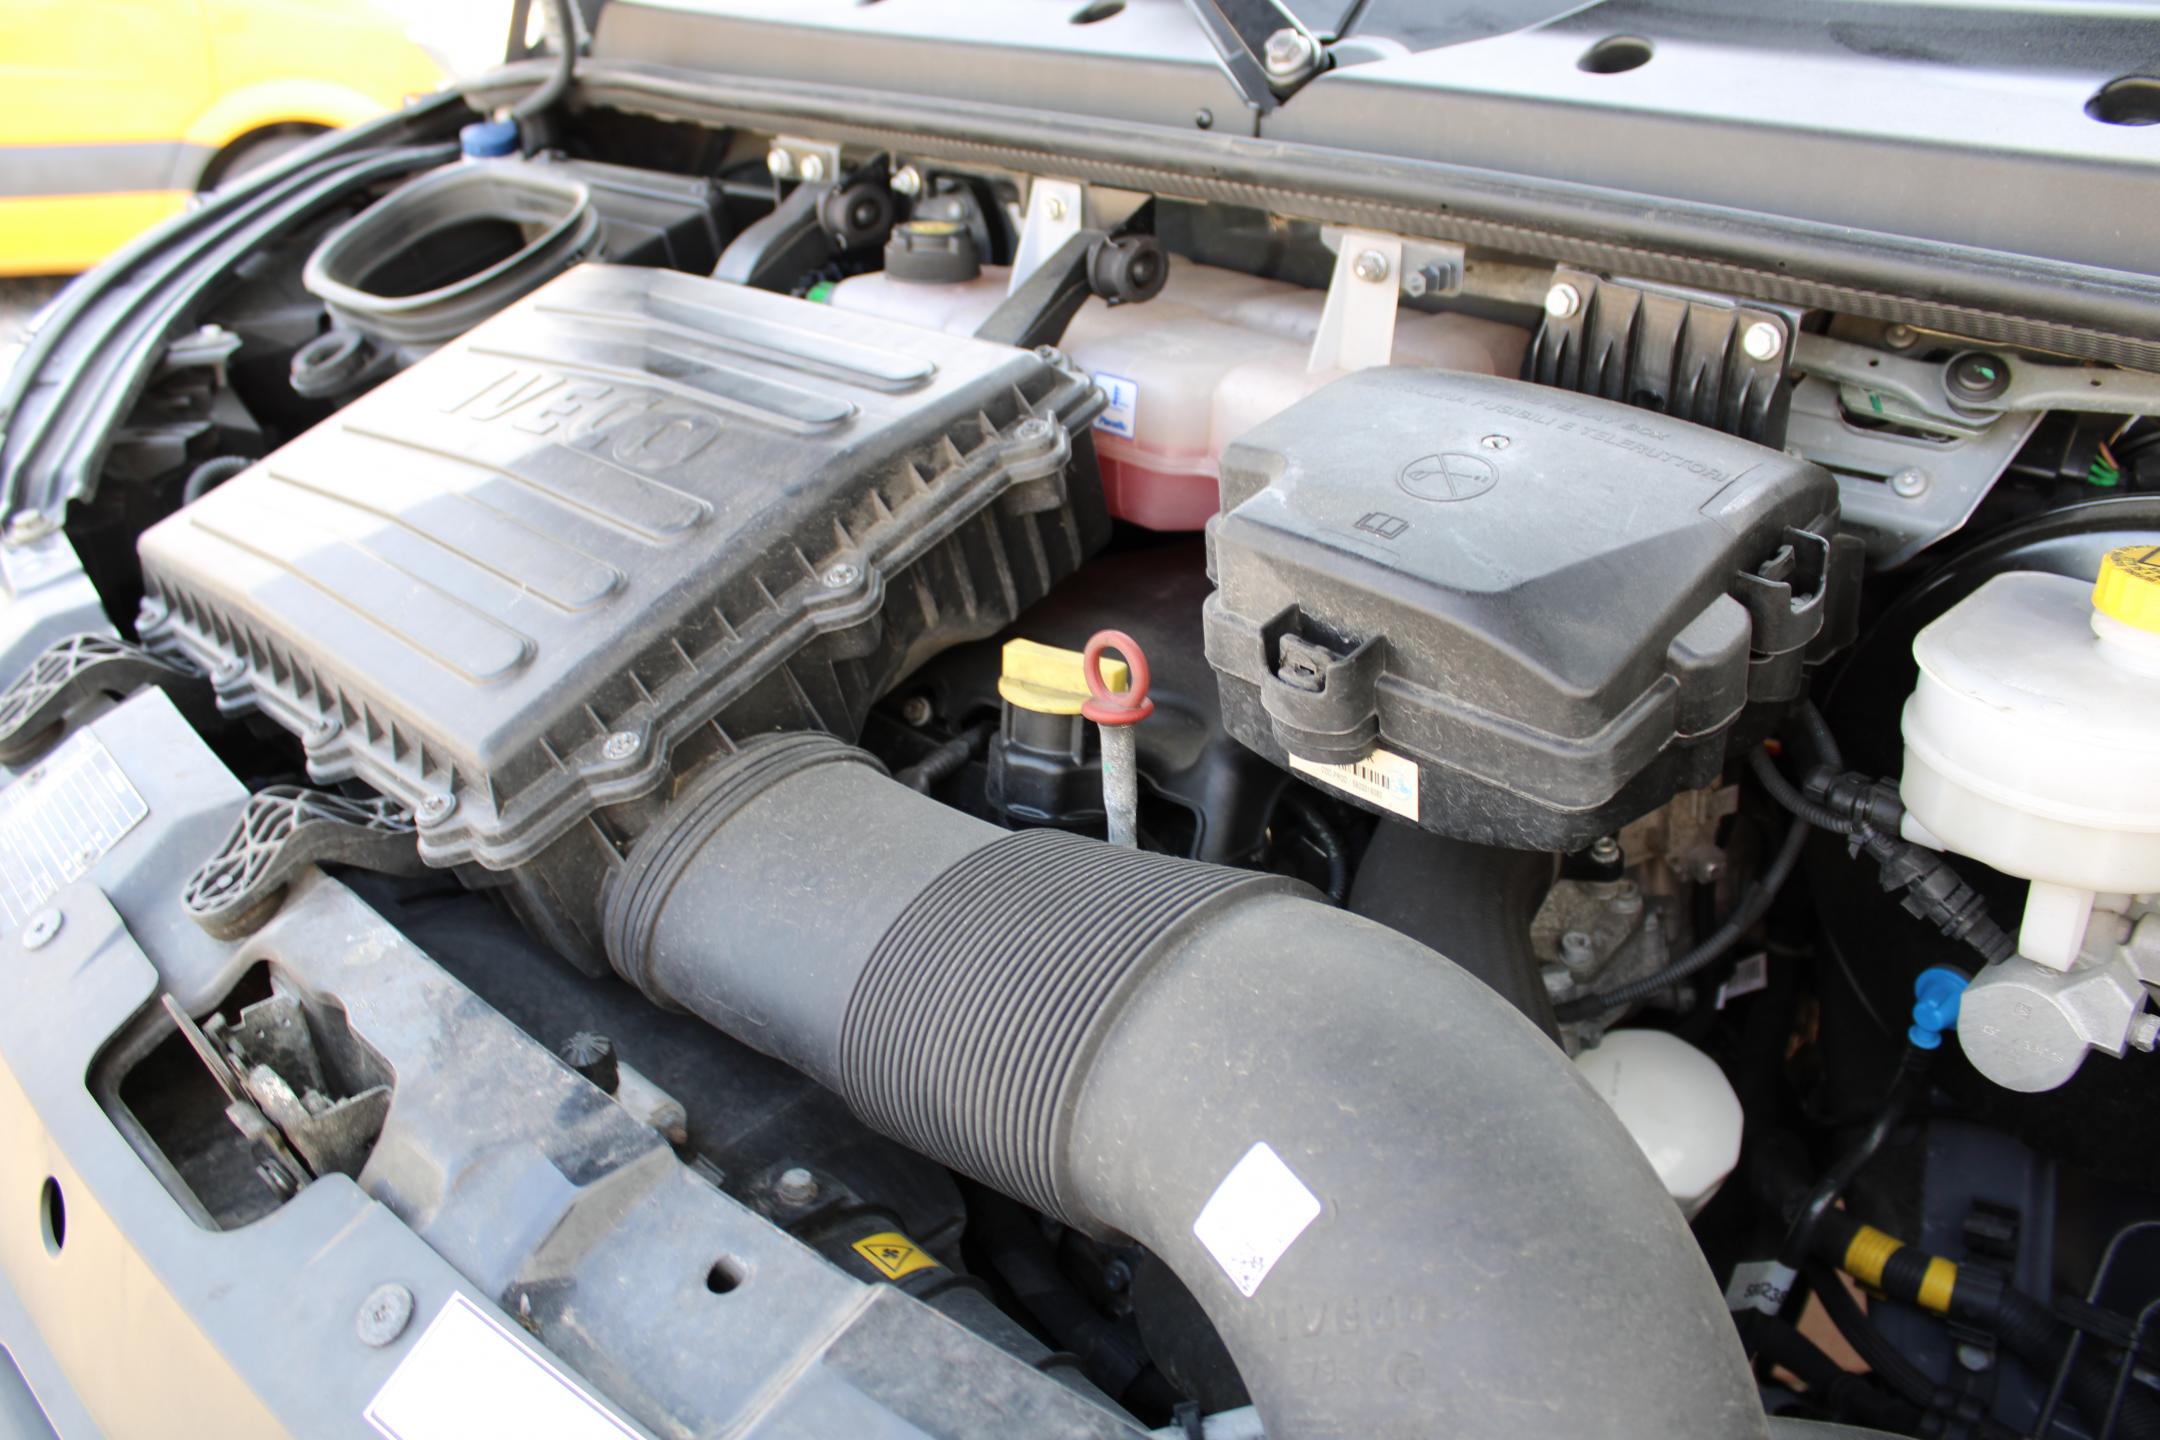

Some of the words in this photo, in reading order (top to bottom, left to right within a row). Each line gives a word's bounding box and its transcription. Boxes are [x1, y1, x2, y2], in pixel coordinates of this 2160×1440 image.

[438, 370, 722, 470] IVECO
[1470, 399, 1556, 426] FUSIBILI
[1579, 424, 1732, 483] TELERUTTORI
